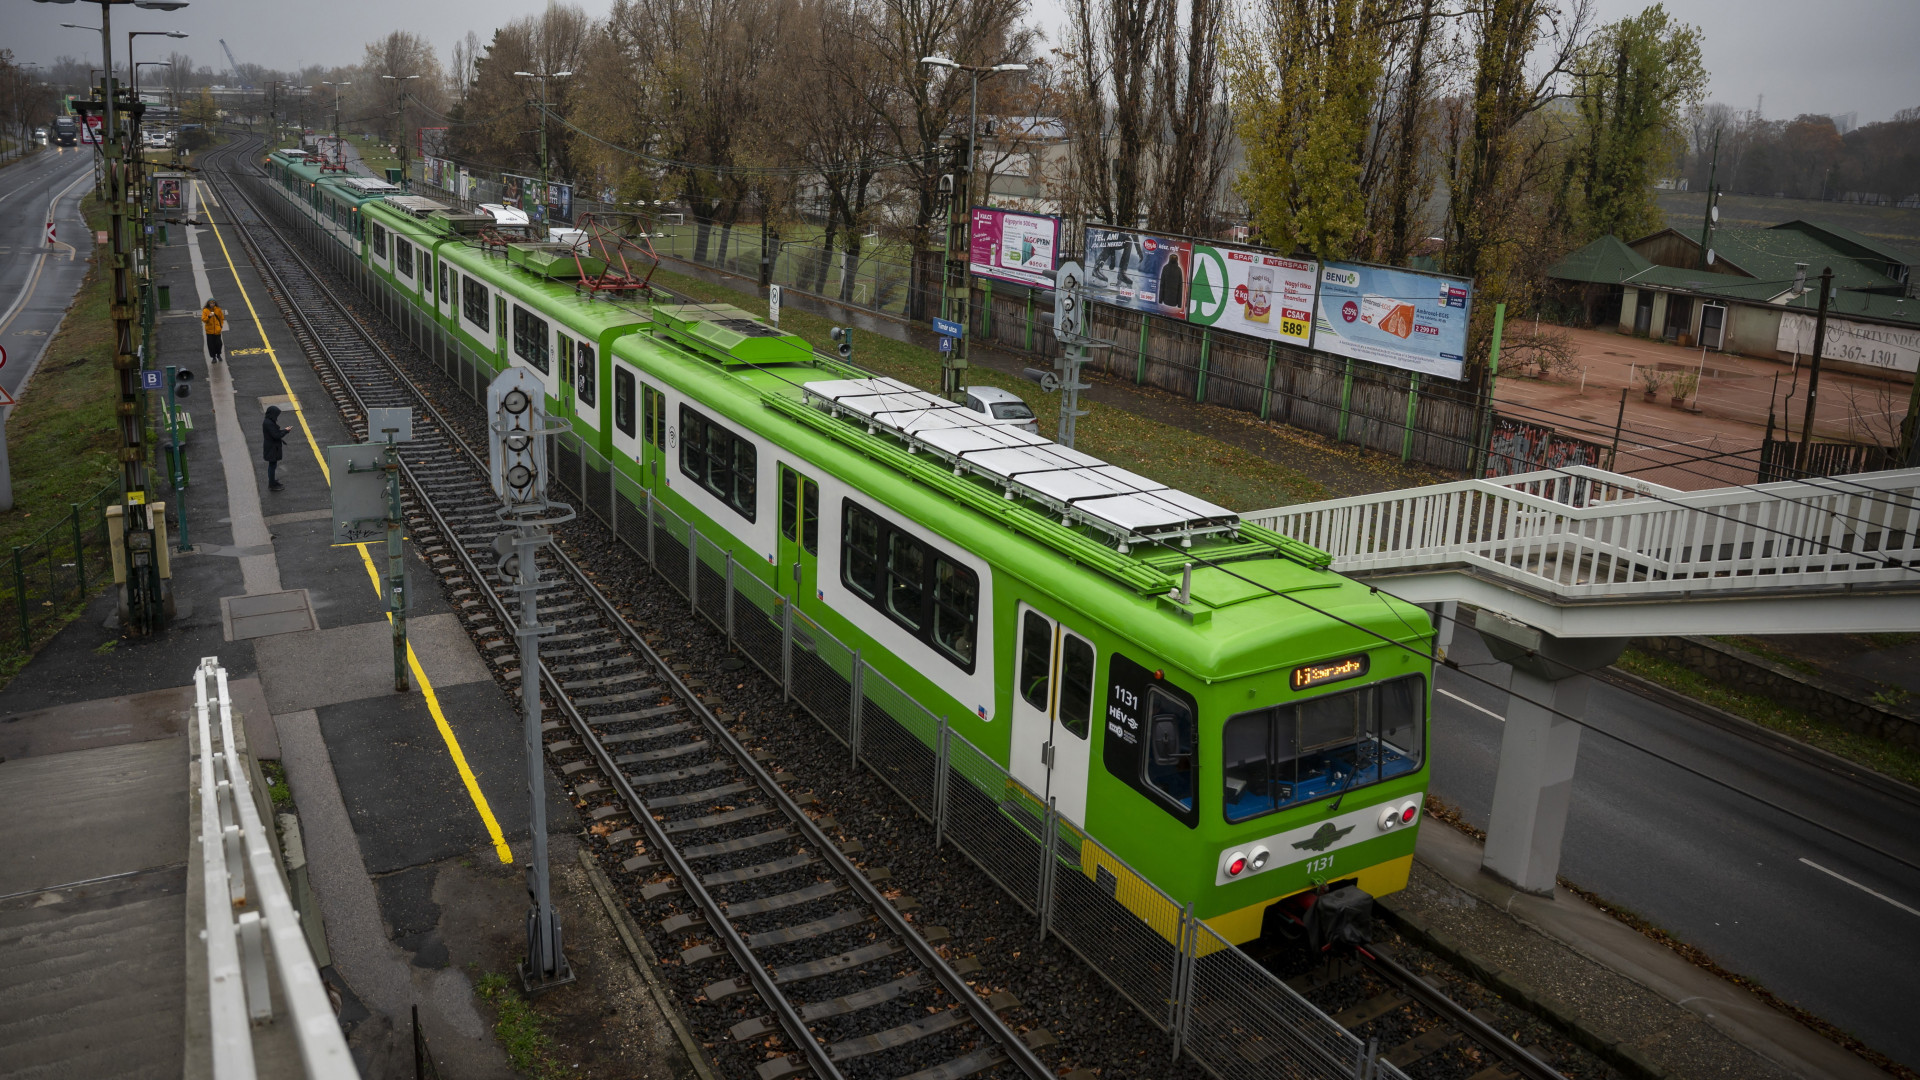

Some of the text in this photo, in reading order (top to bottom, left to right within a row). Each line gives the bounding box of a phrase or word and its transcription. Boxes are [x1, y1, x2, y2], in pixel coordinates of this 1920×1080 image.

[1267, 259, 1308, 271] INTERSPAR
[1326, 272, 1347, 283] BENU
[1285, 280, 1299, 289] Nagyi
[1235, 290, 1248, 301] 2 kg
[1286, 310, 1306, 320] CSAK
[1283, 321, 1302, 335] 589
[148, 374, 156, 383] B
[1115, 685, 1138, 710] 1131
[1110, 705, 1127, 723] HÉV
[1306, 855, 1334, 874] 1131
